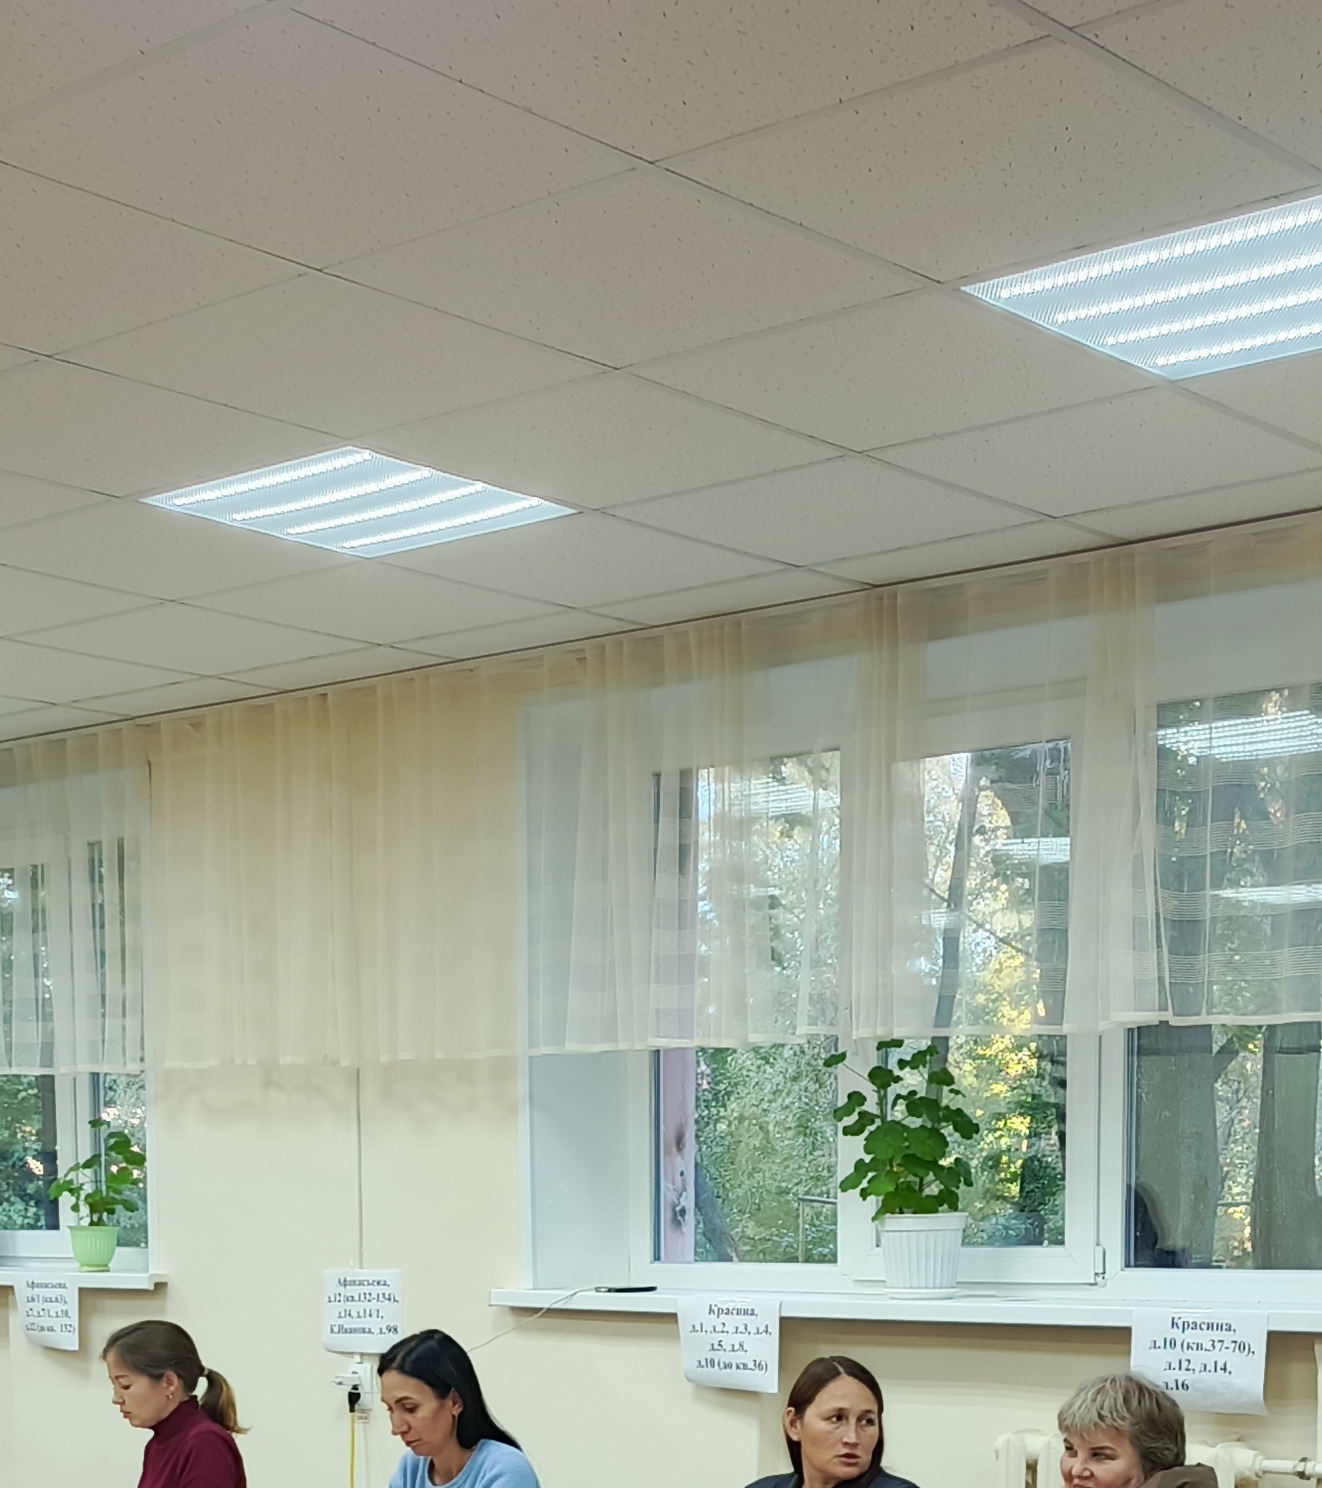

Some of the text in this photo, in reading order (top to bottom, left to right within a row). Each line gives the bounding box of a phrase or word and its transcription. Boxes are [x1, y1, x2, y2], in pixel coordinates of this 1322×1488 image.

[708, 1303, 758, 1319] Красина,
[1171, 1316, 1237, 1334] Красина,
[1148, 1337, 1255, 1357] д.10 (кв.37-70),
[1163, 1358, 1232, 1375] д.12, д.14,
